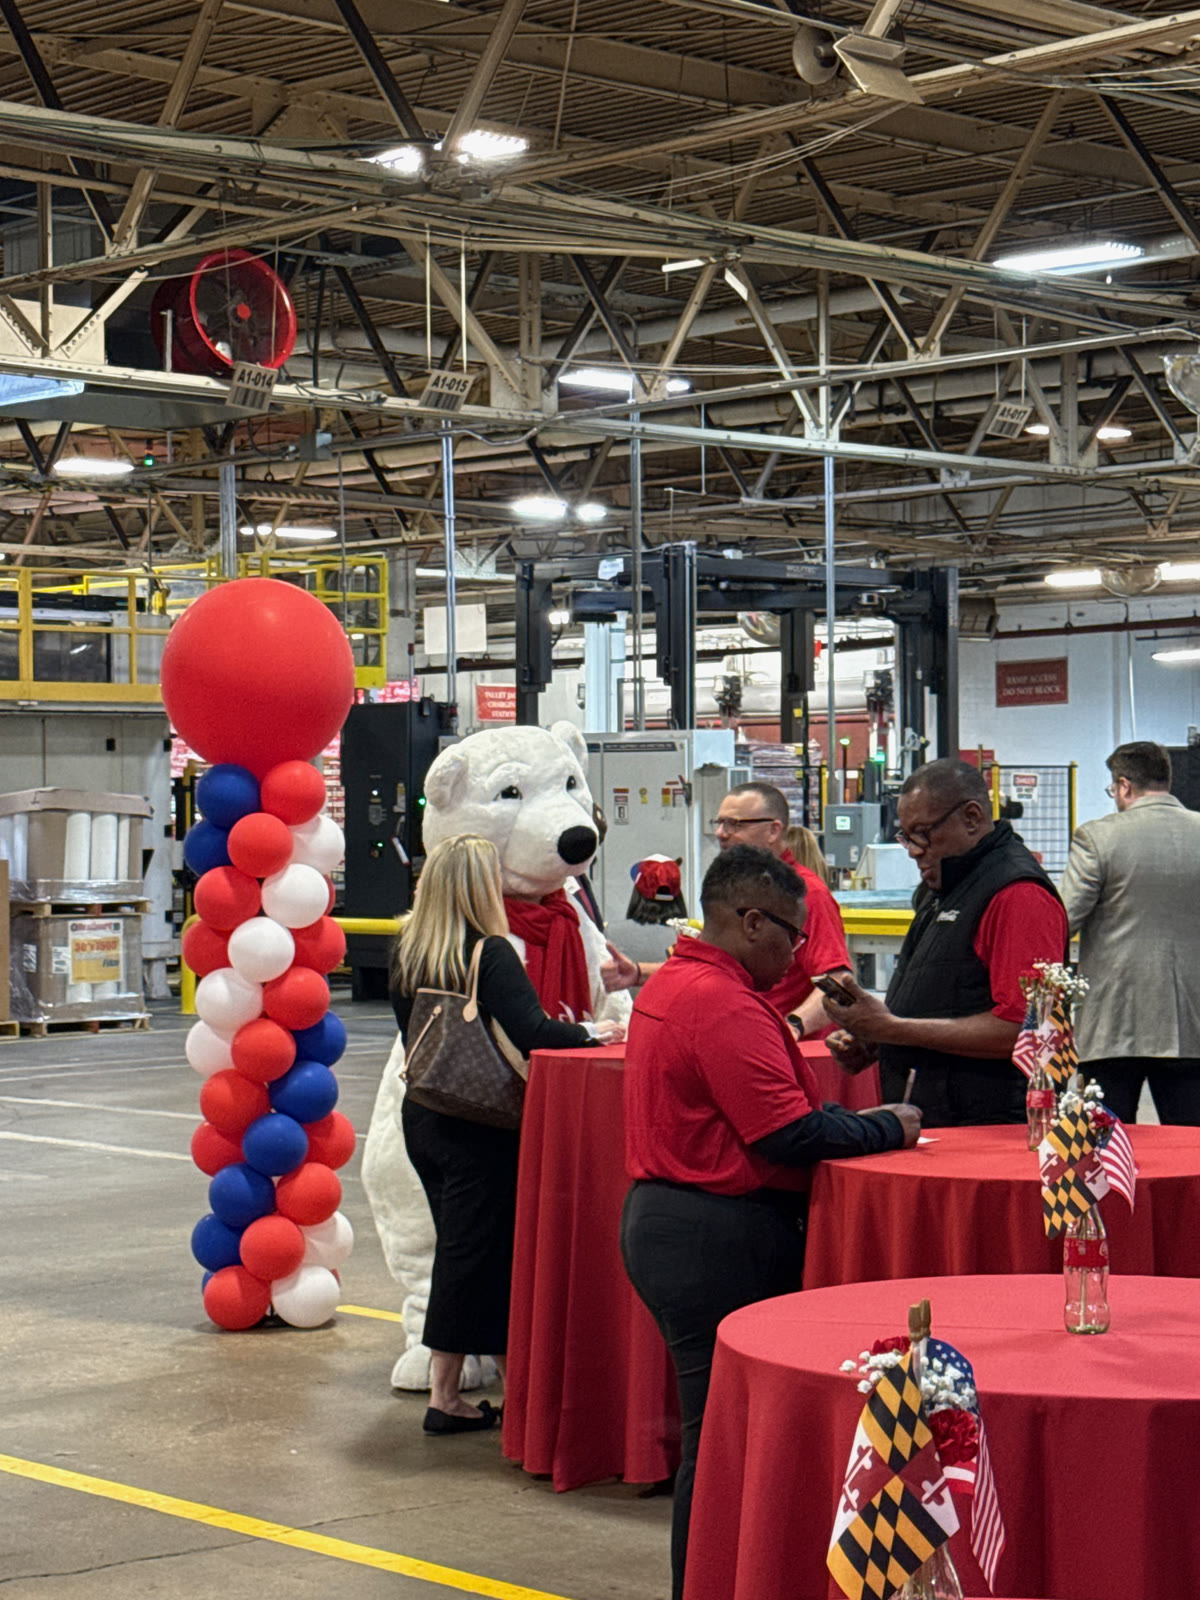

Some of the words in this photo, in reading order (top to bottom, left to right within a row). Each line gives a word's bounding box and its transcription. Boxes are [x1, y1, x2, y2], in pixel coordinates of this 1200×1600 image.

[237, 368, 274, 388] A1-014
[431, 375, 469, 393] A1-015
[999, 406, 1028, 421] A1-017
[1002, 687, 1016, 696] DO
[1016, 687, 1033, 696] NOT
[1034, 684, 1061, 695] BLOCK
